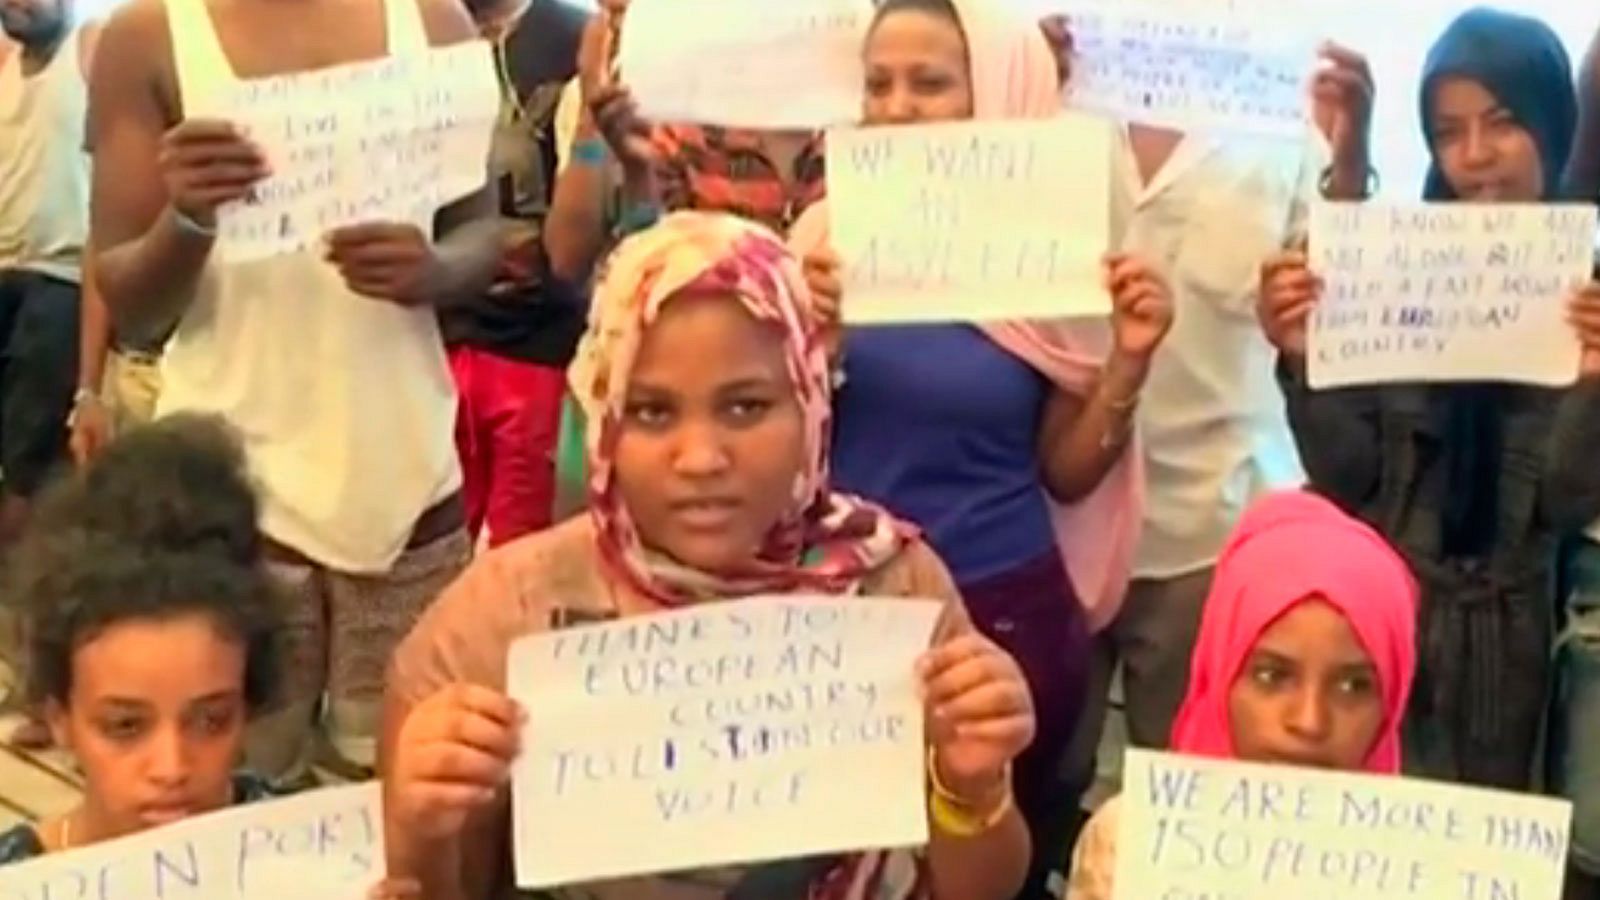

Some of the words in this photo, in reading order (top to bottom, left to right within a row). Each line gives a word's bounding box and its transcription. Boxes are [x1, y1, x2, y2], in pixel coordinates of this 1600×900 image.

[924, 134, 1038, 182] WANT
[585, 640, 843, 696] EUROPEAN
[668, 679, 879, 727] COUNTRY
[654, 768, 808, 821] VOICE
[1148, 762, 1203, 809] WE
[1219, 777, 1316, 822] ARE
[1338, 790, 1466, 842] MORE
[1485, 813, 1565, 864] THAN
[1150, 816, 1250, 872] 150
[1261, 835, 1432, 894] PEOPLE
